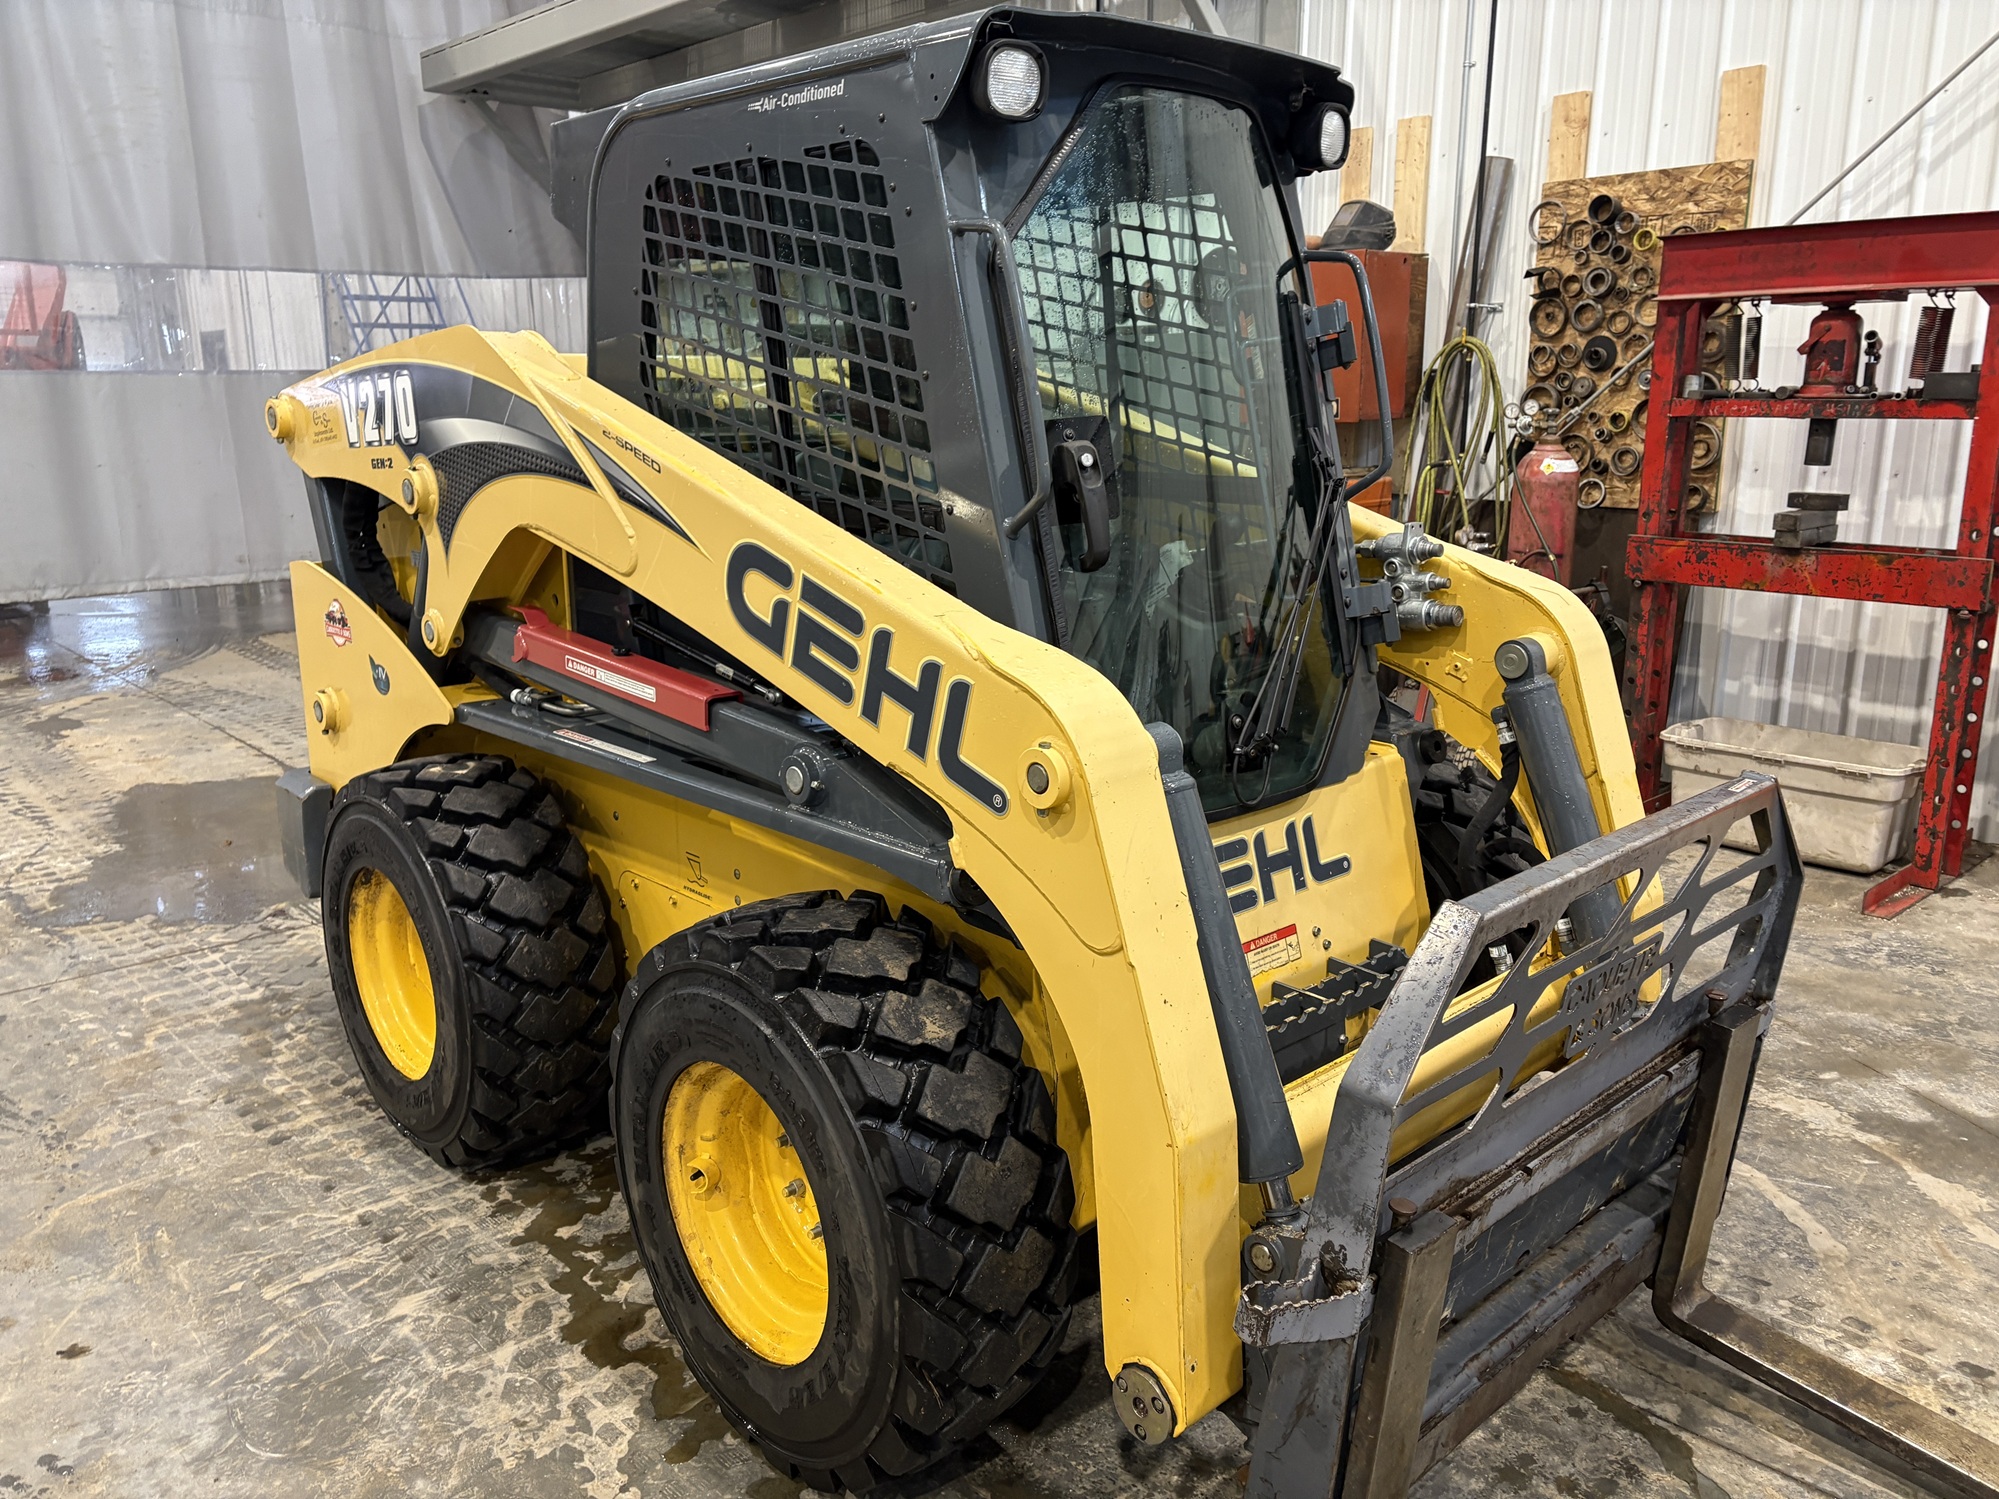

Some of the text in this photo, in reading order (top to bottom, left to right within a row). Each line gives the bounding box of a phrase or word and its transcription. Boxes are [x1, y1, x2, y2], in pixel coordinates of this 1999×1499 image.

[762, 79, 845, 112] Air-Conditioned
[339, 369, 419, 448] V270
[573, 660, 596, 677] DANGER
[1255, 933, 1278, 947] DANGER
